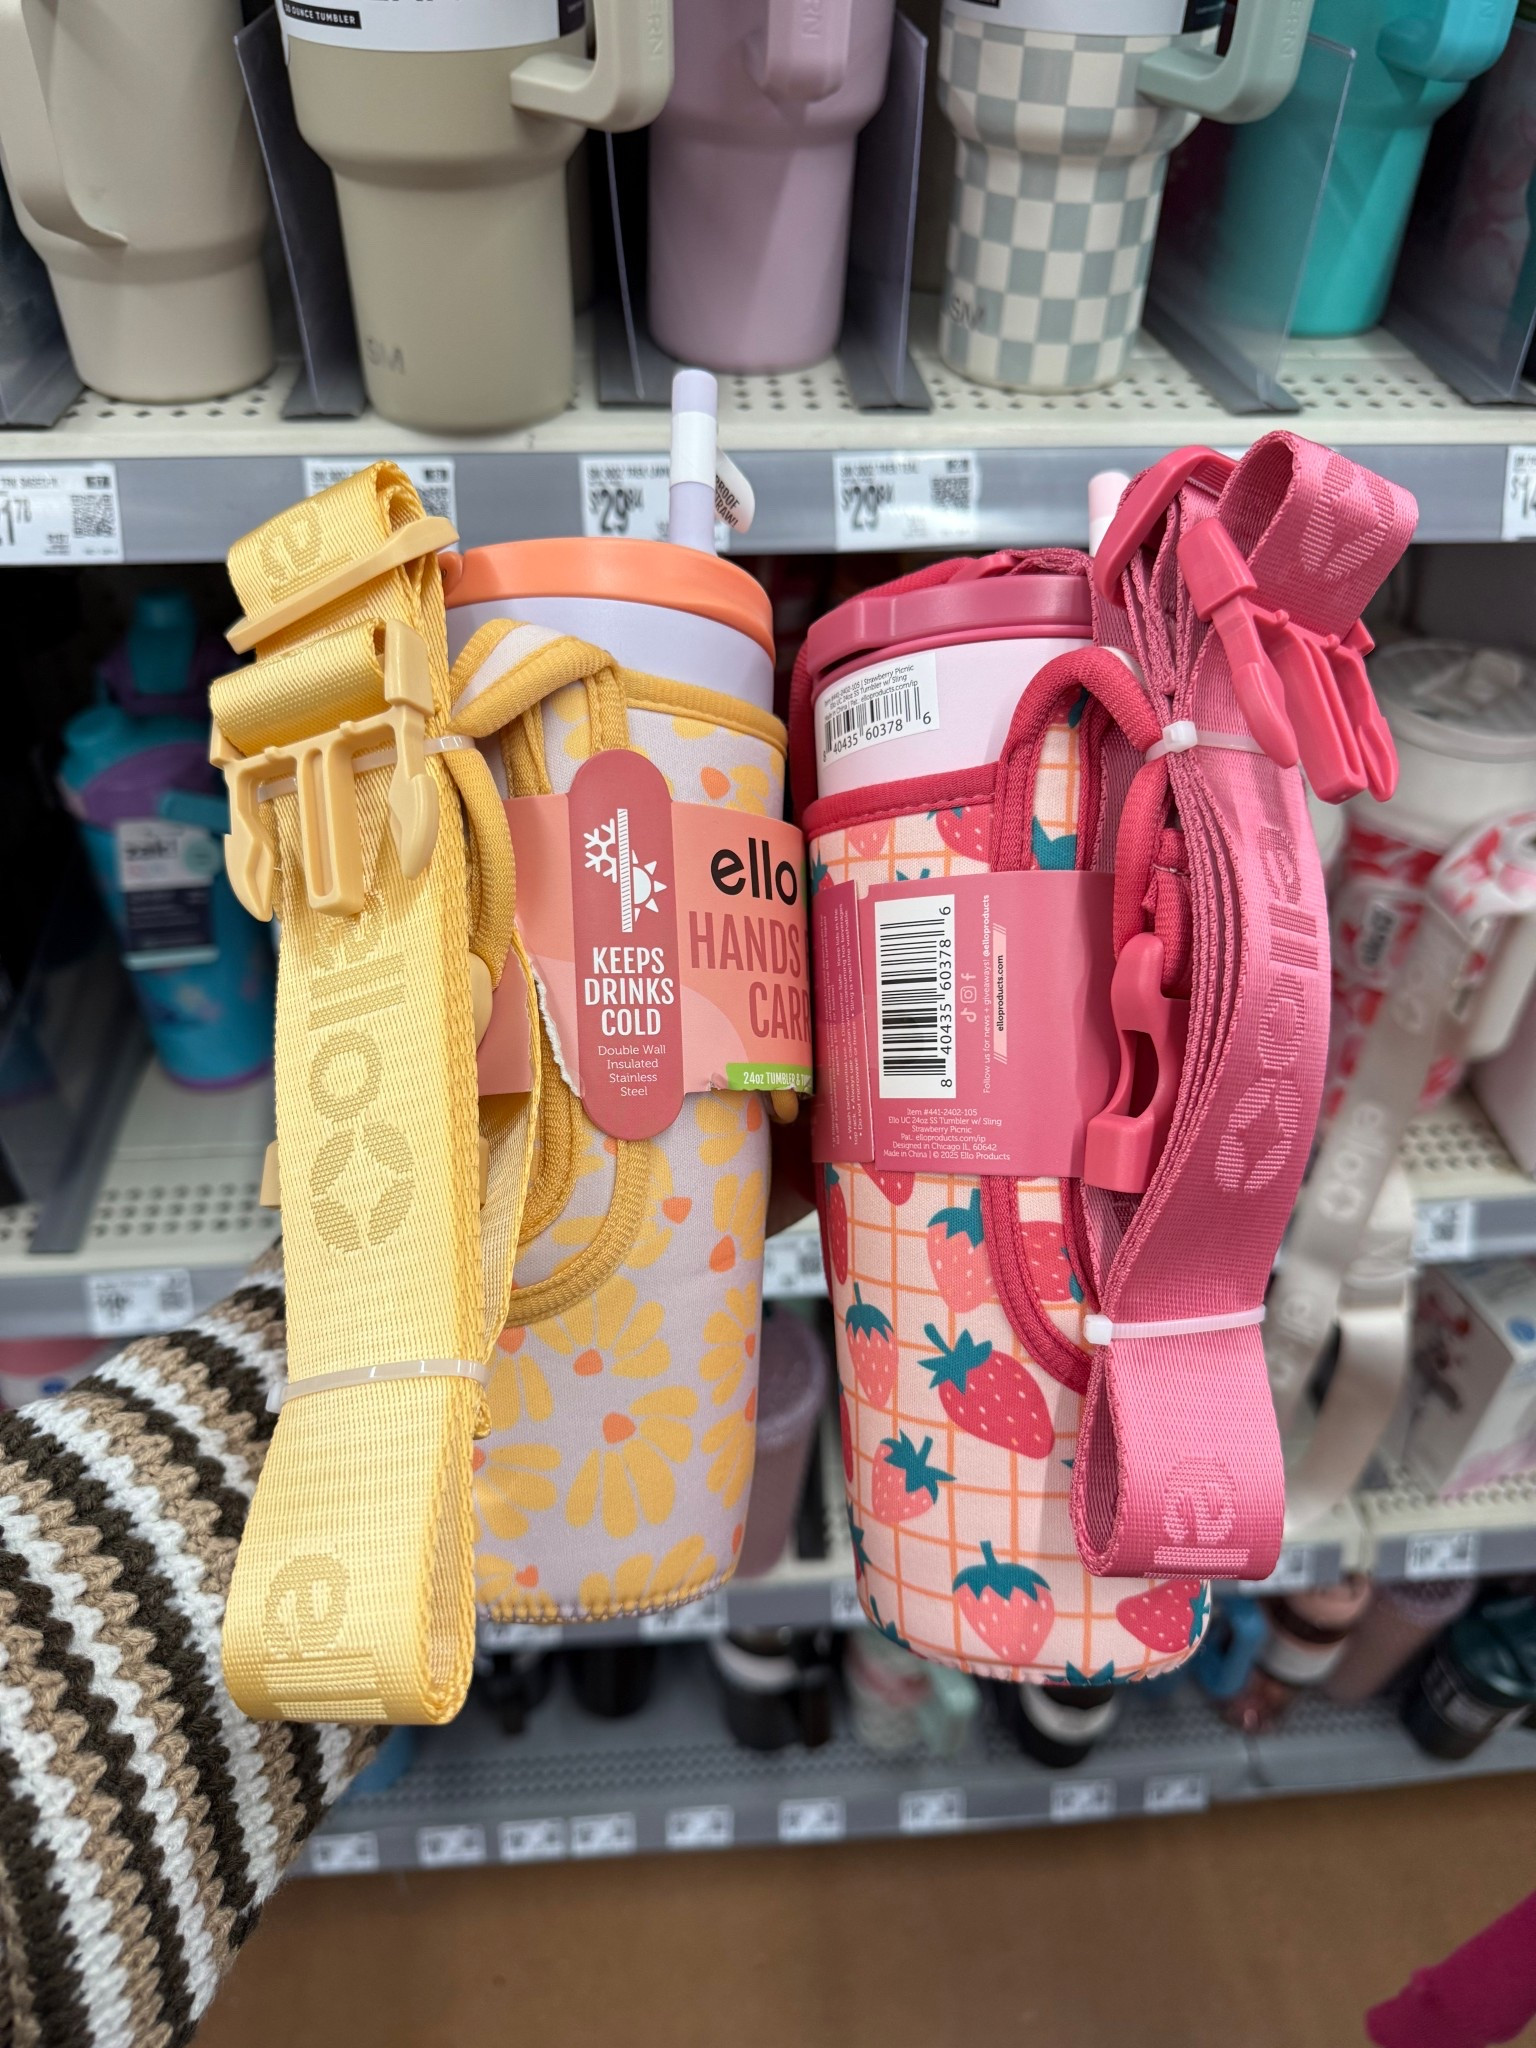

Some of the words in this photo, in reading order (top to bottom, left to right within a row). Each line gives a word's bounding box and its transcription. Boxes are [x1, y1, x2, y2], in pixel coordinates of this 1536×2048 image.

[291, 6, 314, 19] OUNCE
[314, 11, 356, 25] TUMBLER
[860, 682, 882, 694] Tumbler
[892, 674, 908, 684] Sling
[863, 670, 894, 685] Strawberry
[895, 664, 914, 675] Picnic
[860, 680, 918, 702] elloproducts.com/ip
[833, 733, 858, 754] 40435
[865, 719, 903, 740] 60378
[923, 711, 932, 725] 6
[711, 837, 798, 906] ello
[939, 906, 951, 915] 6
[981, 894, 991, 957] @elloproducts
[689, 911, 801, 978] HANDS
[1257, 826, 1319, 1069] ello
[593, 947, 665, 974] KEEPS
[939, 939, 951, 990] 60378
[584, 977, 675, 1006] DRINKS
[982, 959, 992, 1005] giveaways!
[996, 955, 1005, 1031] elloproducts.com
[601, 1008, 661, 1037] COLD
[939, 1003, 952, 1055] 40435
[983, 1015, 991, 1037] news
[597, 1045, 640, 1056] Double
[643, 1044, 666, 1054] Wall
[983, 1039, 991, 1051] for
[607, 1059, 659, 1070] Insulated
[984, 1053, 991, 1063] us
[609, 1073, 657, 1083] Stainless
[743, 1071, 764, 1085] 24oz
[765, 1072, 795, 1086] TUMBLER
[940, 1078, 953, 1088] 8
[983, 1066, 991, 1094] Follow
[620, 1086, 648, 1097] Steel
[907, 1108, 922, 1116] Item
[923, 1108, 977, 1117] #441-2402-105
[939, 1117, 970, 1125] Tumbler
[971, 1118, 981, 1126] w/
[983, 1118, 1002, 1127] Sling
[912, 1125, 948, 1134] Strawberry
[950, 1126, 972, 1134] Picnic
[915, 1133, 986, 1143] elloproducts.com/ip
[883, 1149, 899, 1157] Made
[908, 1150, 928, 1158] China
[941, 1151, 959, 1159] 2025
[960, 1152, 974, 1160] Ello
[976, 1152, 1010, 1161] Products
[893, 1141, 921, 1150] Designed
[931, 1142, 960, 1152] Chicago
[973, 1143, 997, 1152] 60642
